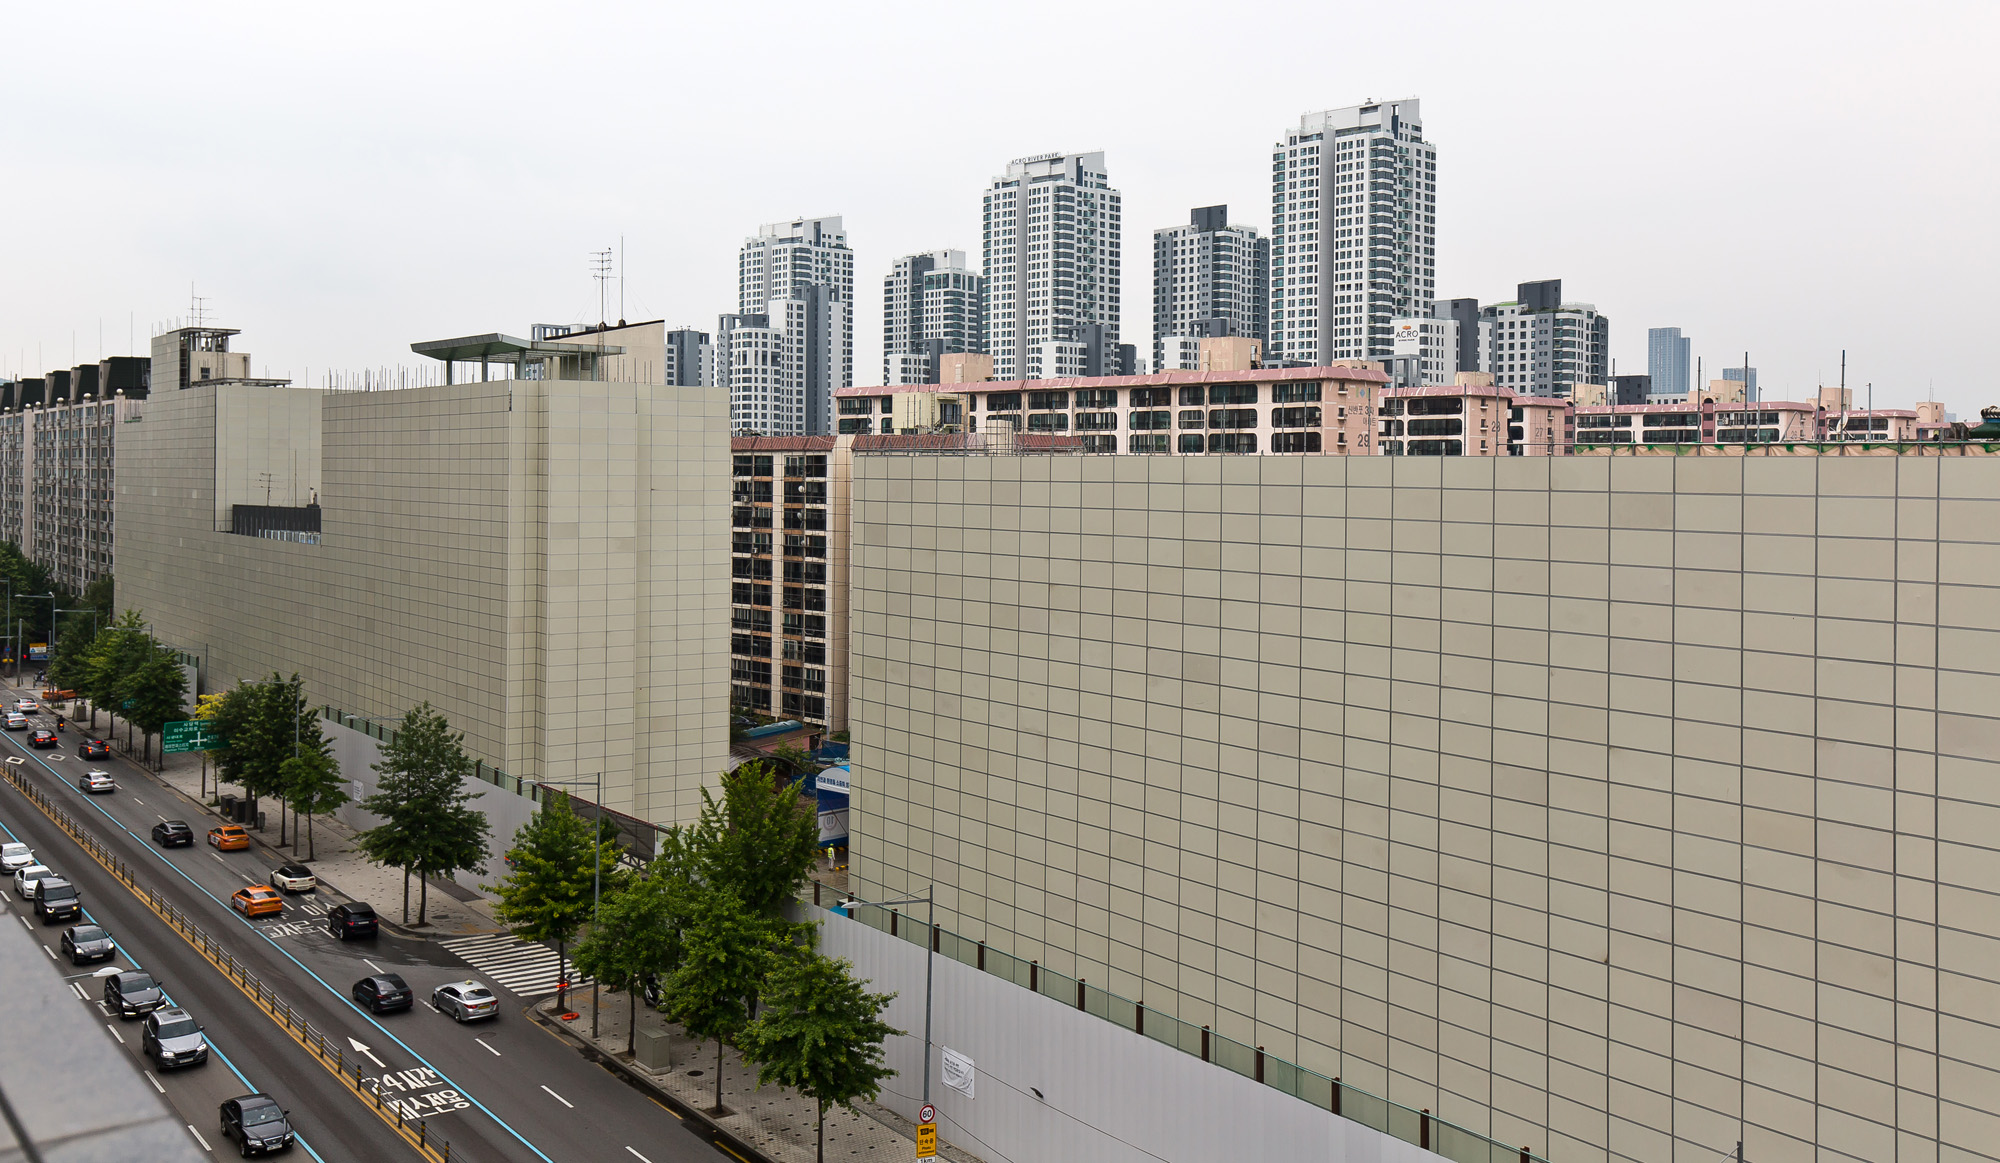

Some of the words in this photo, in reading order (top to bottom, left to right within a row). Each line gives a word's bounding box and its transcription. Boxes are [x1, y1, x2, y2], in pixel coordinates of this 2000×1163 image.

[1396, 330, 1418, 338] ACRO
[1535, 428, 1543, 437] 27
[1357, 434, 1370, 447] 29
[361, 1067, 443, 1096] 24시간
[387, 1090, 471, 1120] 버스전용
[923, 1110, 932, 1118] 60
